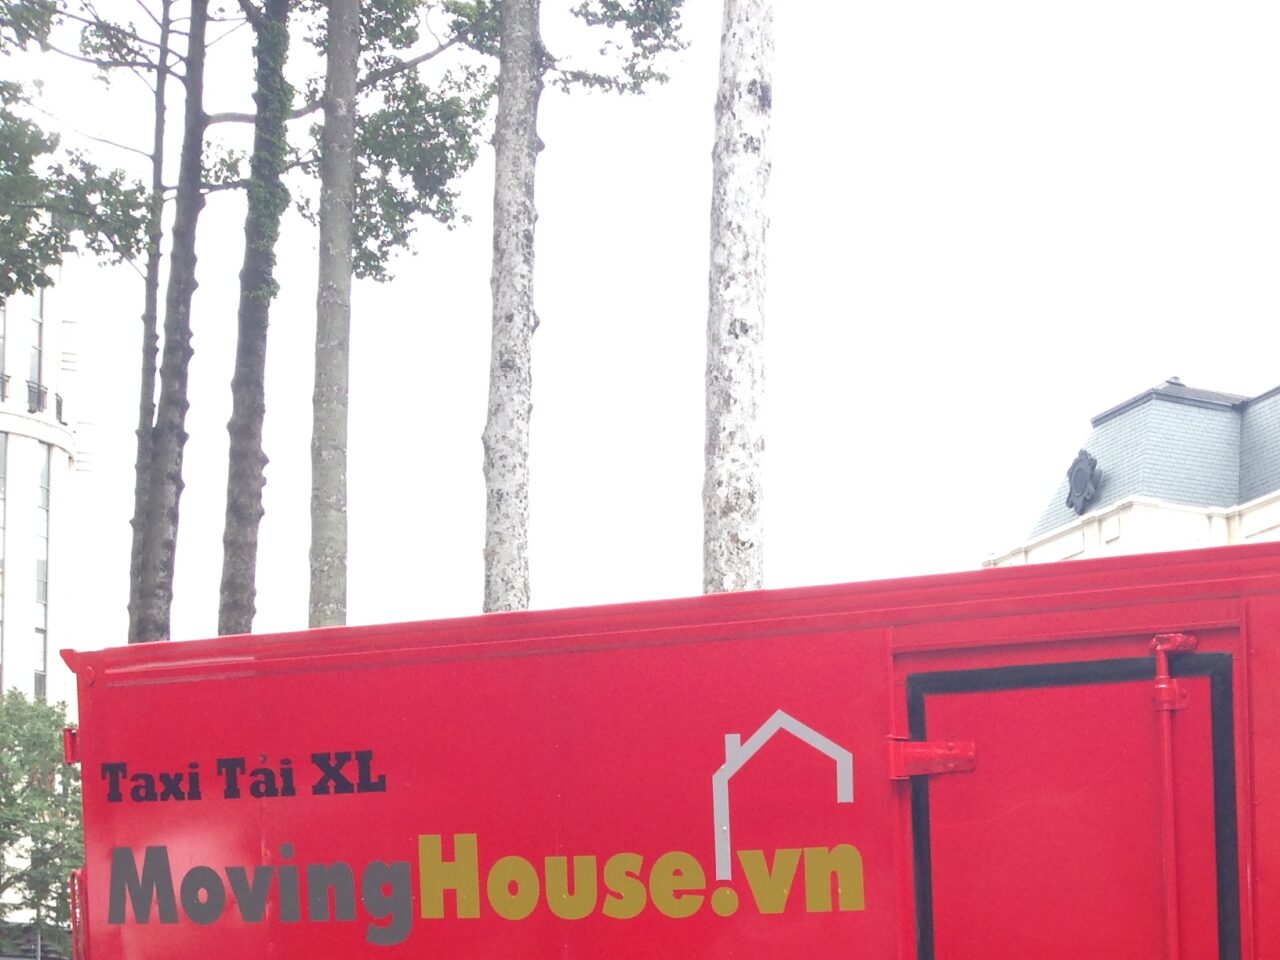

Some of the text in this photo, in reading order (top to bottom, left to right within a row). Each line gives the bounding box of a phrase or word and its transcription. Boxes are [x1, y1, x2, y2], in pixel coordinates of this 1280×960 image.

[101, 750, 386, 802] Taxi Tải XL
[108, 833, 865, 946] MovingHouse.vn
